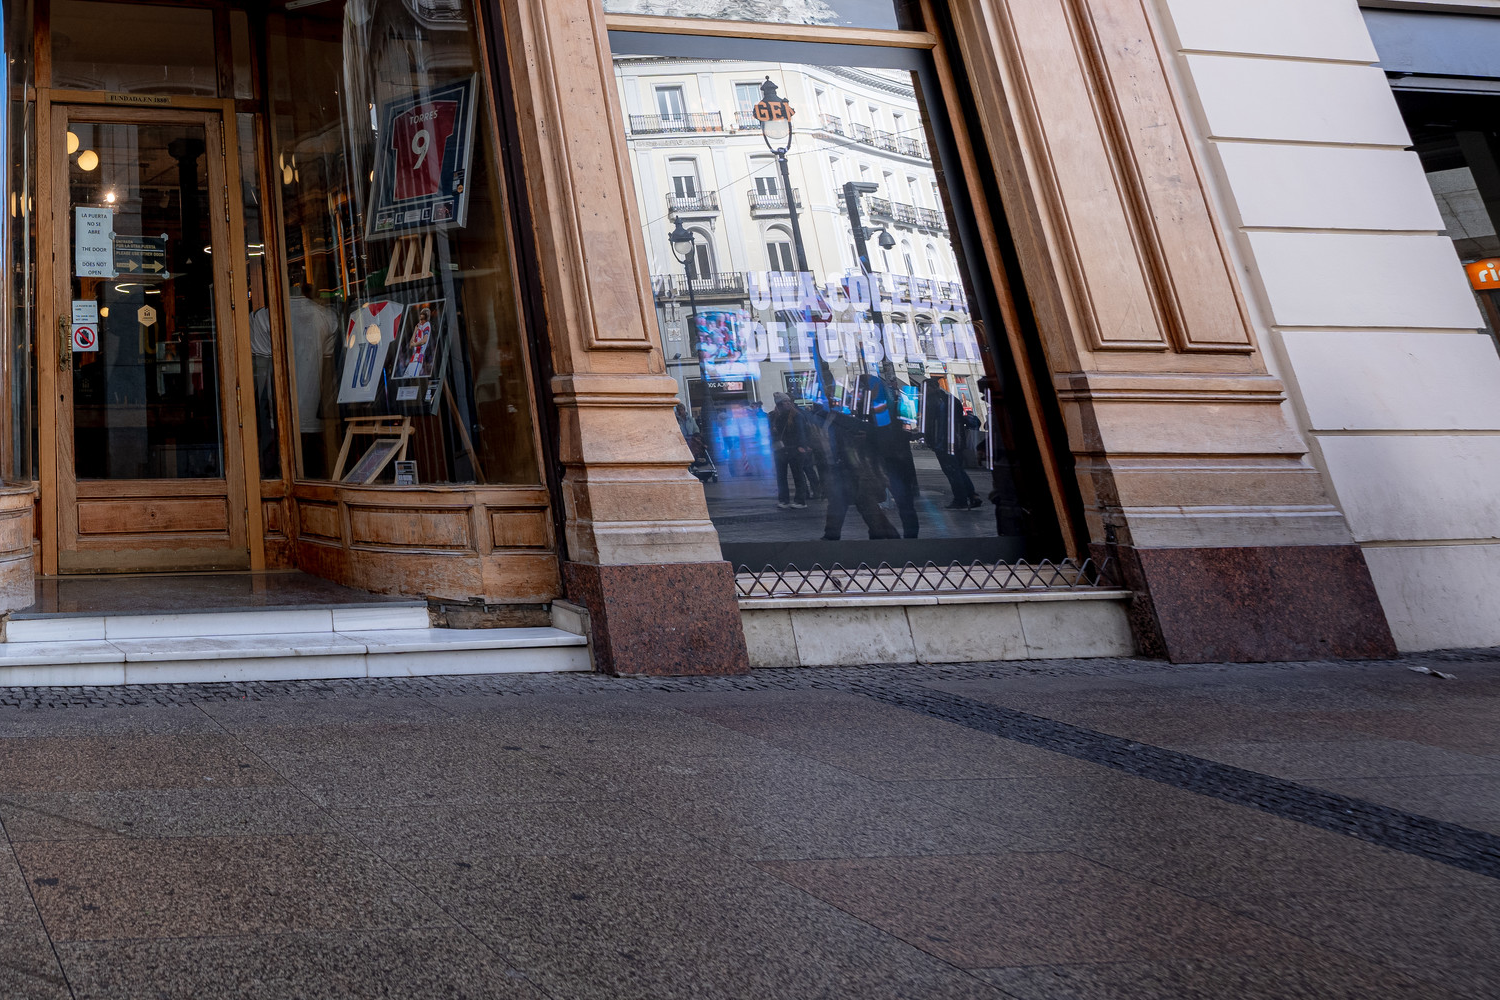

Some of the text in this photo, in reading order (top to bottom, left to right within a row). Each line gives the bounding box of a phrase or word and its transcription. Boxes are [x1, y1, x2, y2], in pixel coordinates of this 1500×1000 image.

[110, 95, 142, 103] FUNDADA
[409, 110, 438, 125] TORRES
[411, 129, 431, 170] 9
[1479, 262, 1500, 283] ri
[351, 342, 379, 388] 10
